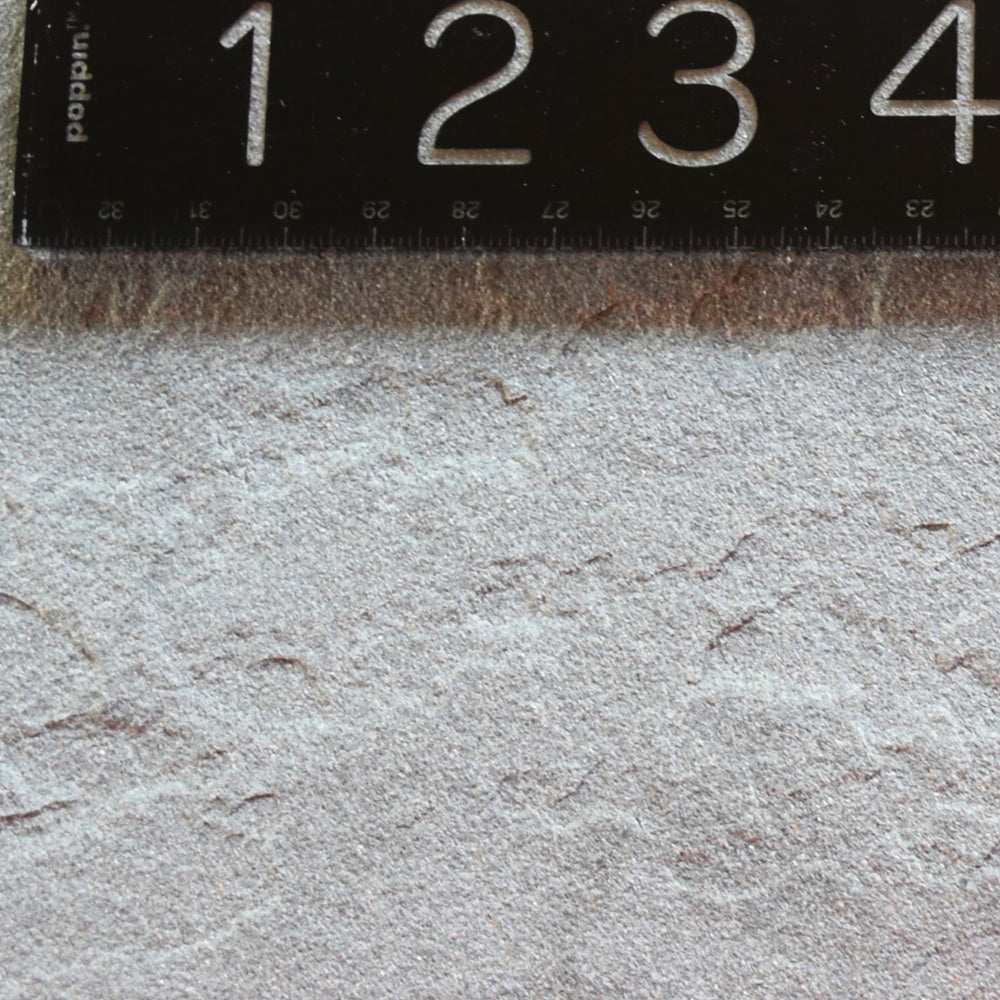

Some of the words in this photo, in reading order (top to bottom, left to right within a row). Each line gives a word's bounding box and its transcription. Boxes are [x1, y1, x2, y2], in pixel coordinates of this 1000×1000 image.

[220, 4, 272, 166] 1
[418, 0, 533, 166] 2
[99, 202, 125, 219] 32
[190, 202, 210, 219] 31
[273, 201, 301, 218] 30
[363, 201, 390, 218] 29
[453, 201, 480, 217] 28
[541, 200, 568, 217] 27
[632, 200, 660, 217] 26
[723, 200, 751, 216] 25
[816, 200, 843, 216] 24
[906, 199, 934, 215] 23
